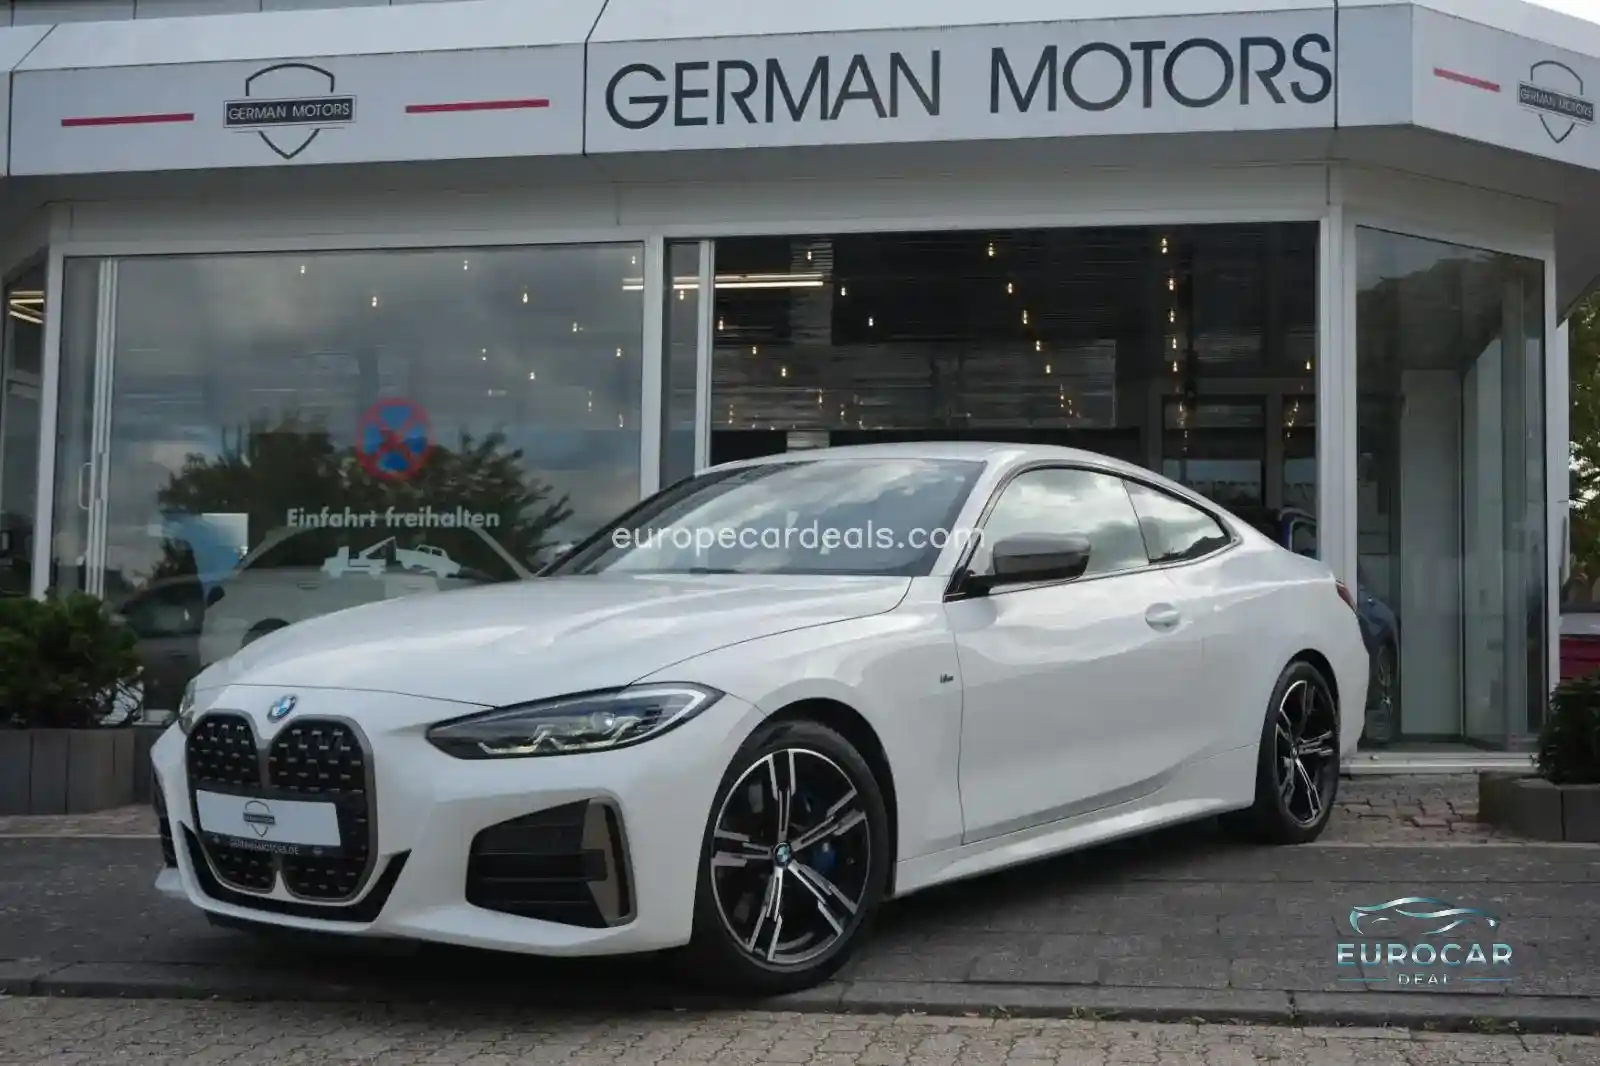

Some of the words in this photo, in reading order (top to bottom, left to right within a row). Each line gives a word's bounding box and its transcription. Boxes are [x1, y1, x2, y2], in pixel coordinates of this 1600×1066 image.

[605, 50, 941, 130] GERMAN
[990, 33, 1332, 113] MOTORS
[228, 106, 286, 120] GERMAN
[292, 103, 350, 117] MOTORS
[286, 506, 376, 528] Einfahrt
[385, 505, 500, 528] freihalten
